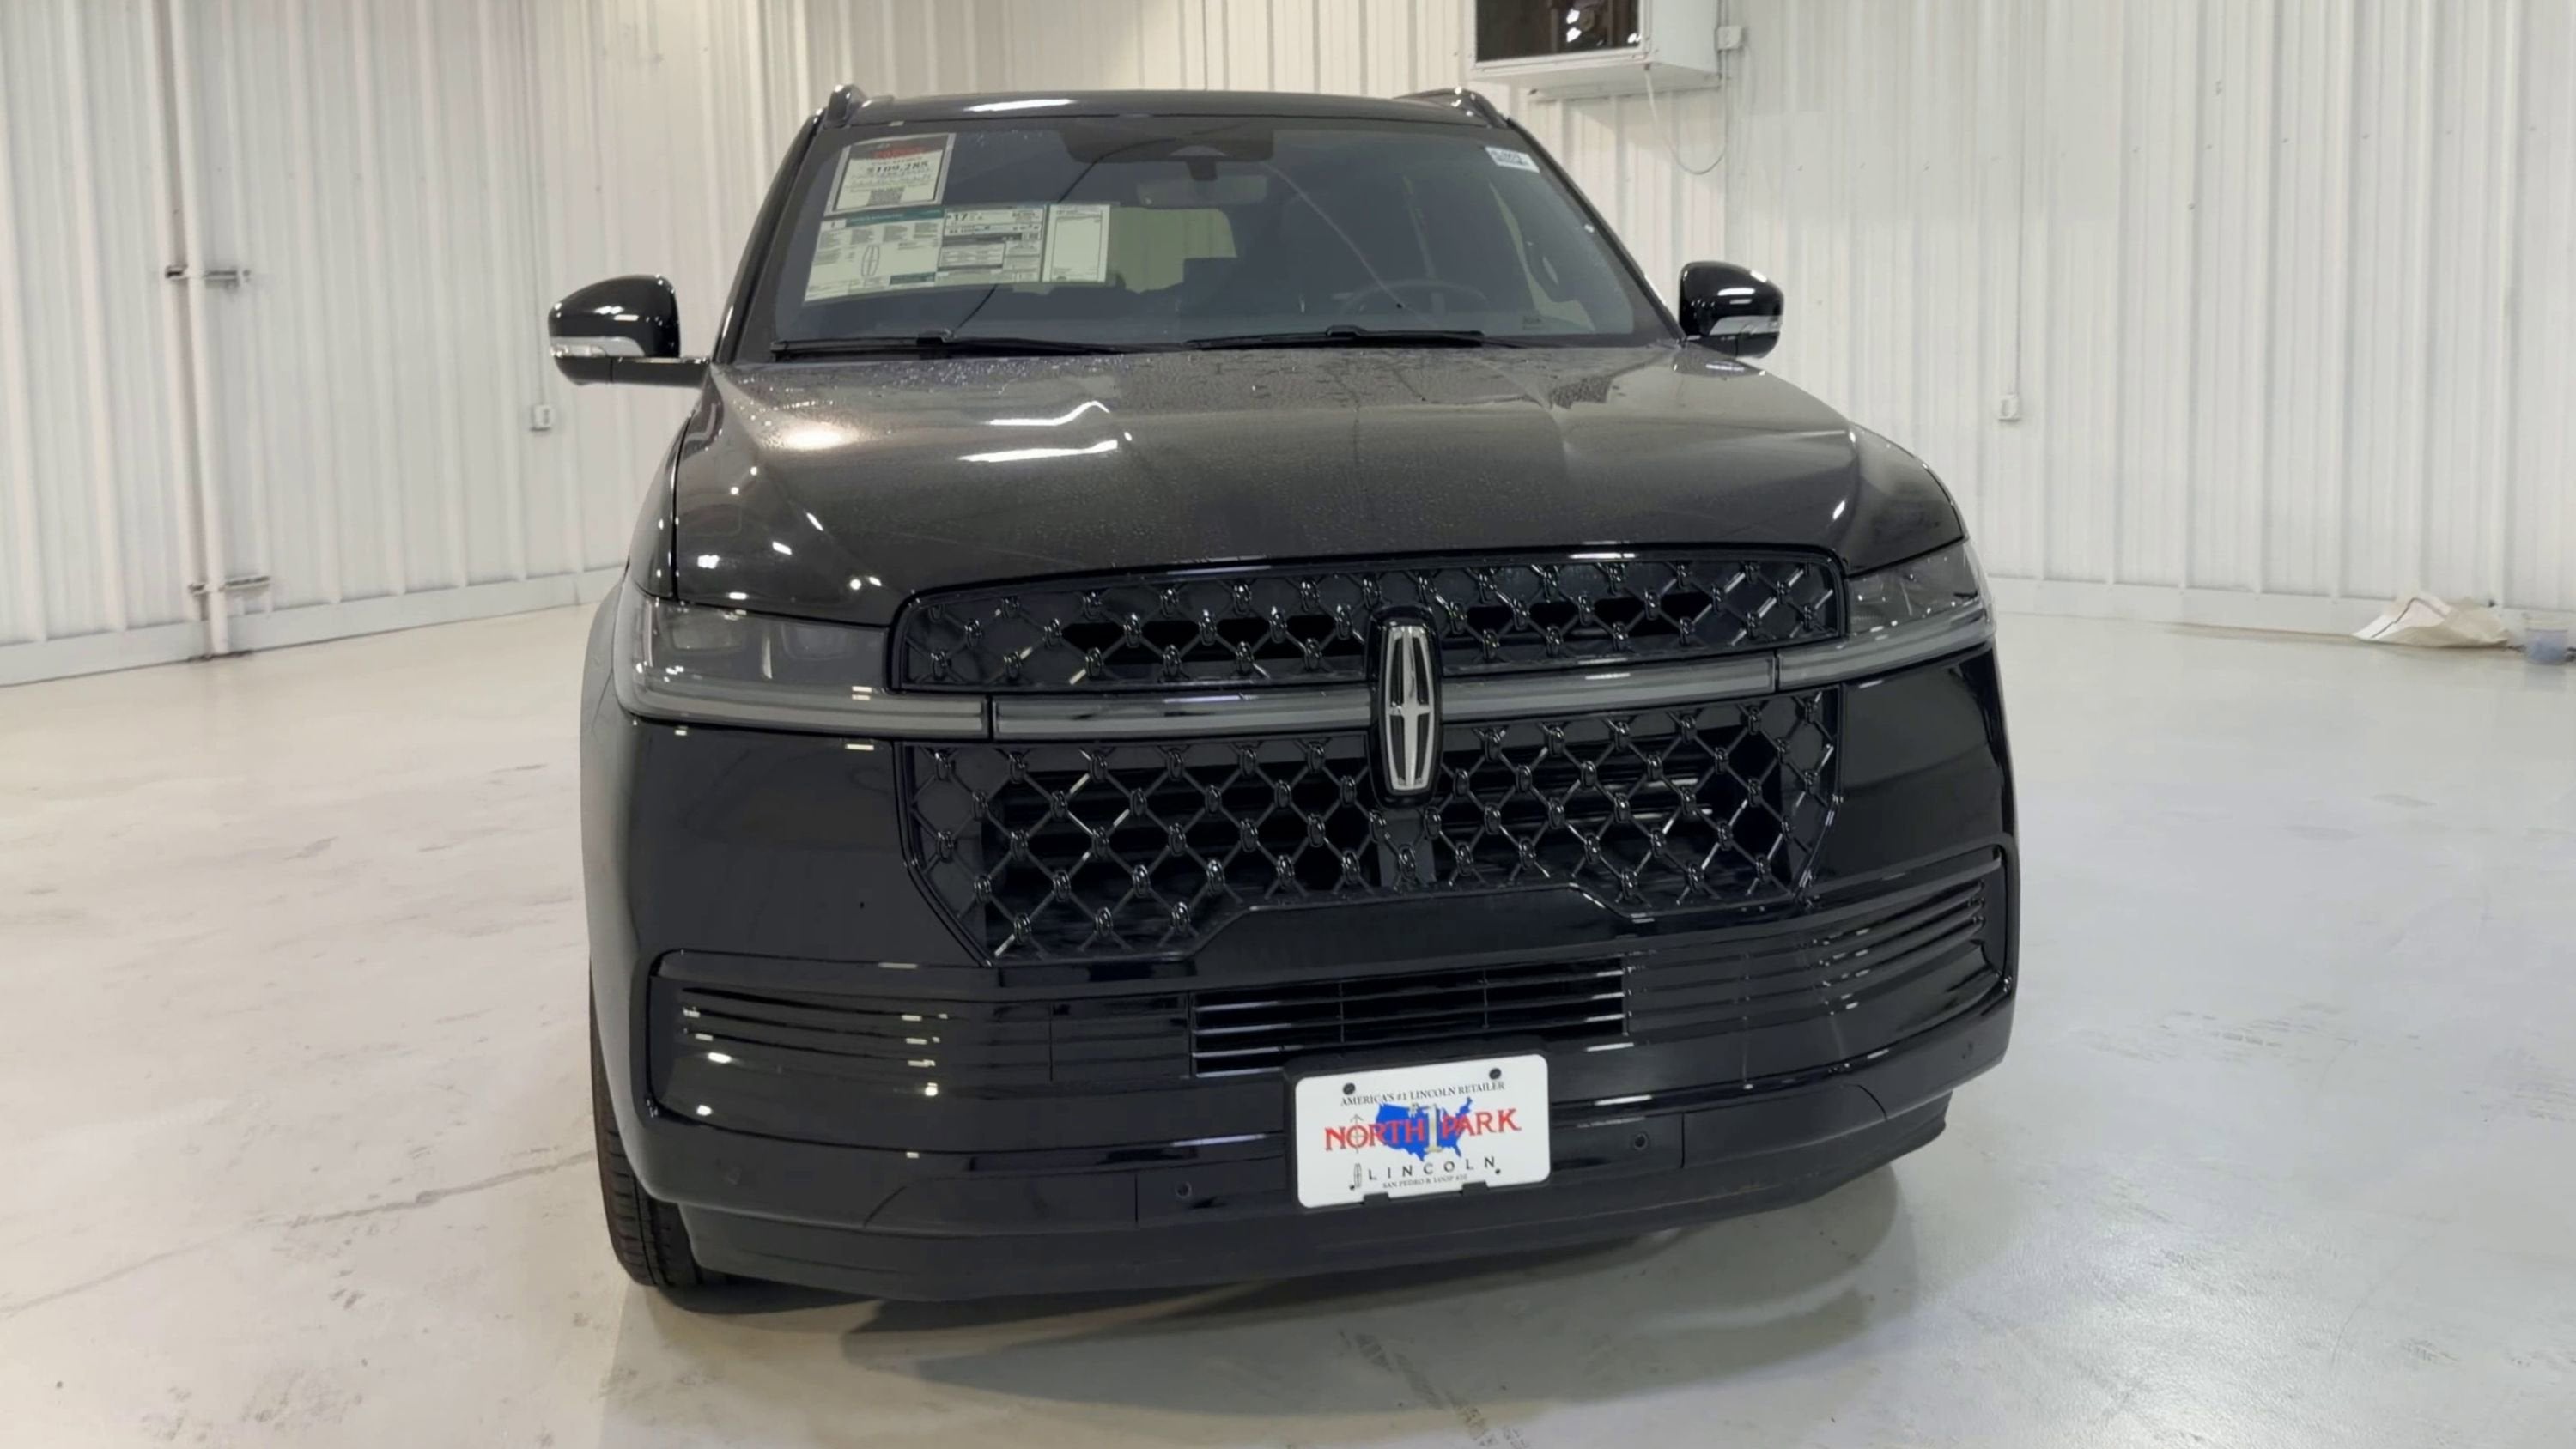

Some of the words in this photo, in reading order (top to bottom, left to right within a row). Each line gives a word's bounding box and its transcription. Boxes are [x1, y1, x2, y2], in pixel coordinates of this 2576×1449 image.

[1340, 1091, 1394, 1106] AMERICA'S
[1396, 1092, 1408, 1101] #1
[1410, 1086, 1456, 1100] LINCOLN
[1457, 1081, 1505, 1095] RETAILER
[1324, 1119, 1425, 1151] NORTH
[1442, 1108, 1522, 1139] PARK
[1368, 1155, 1495, 1180] LINCOLN
[1399, 1178, 1424, 1187] PEDRO
